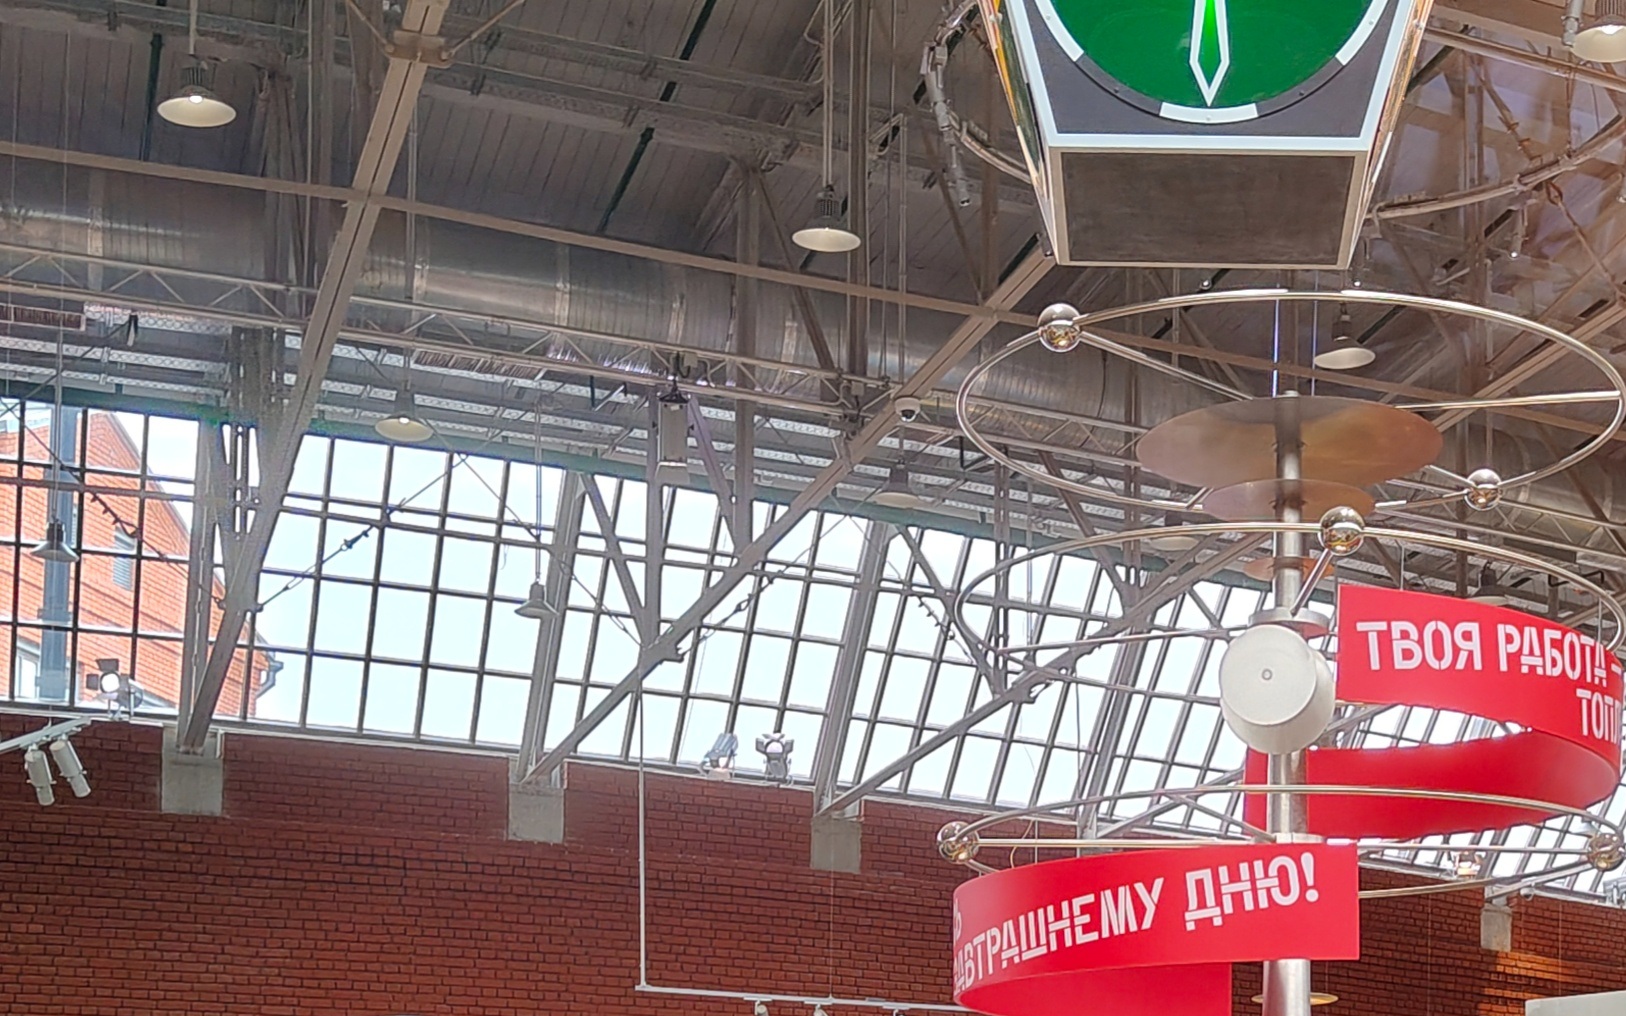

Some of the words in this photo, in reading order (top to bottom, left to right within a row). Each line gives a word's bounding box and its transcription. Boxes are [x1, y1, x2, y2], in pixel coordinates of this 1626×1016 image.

[1356, 620, 1483, 671] ТВОЯ
[1496, 623, 1608, 688] РАБОТА
[954, 877, 1165, 997] АВТРАШНЕМУ
[1184, 852, 1320, 932] ДНЮ!
